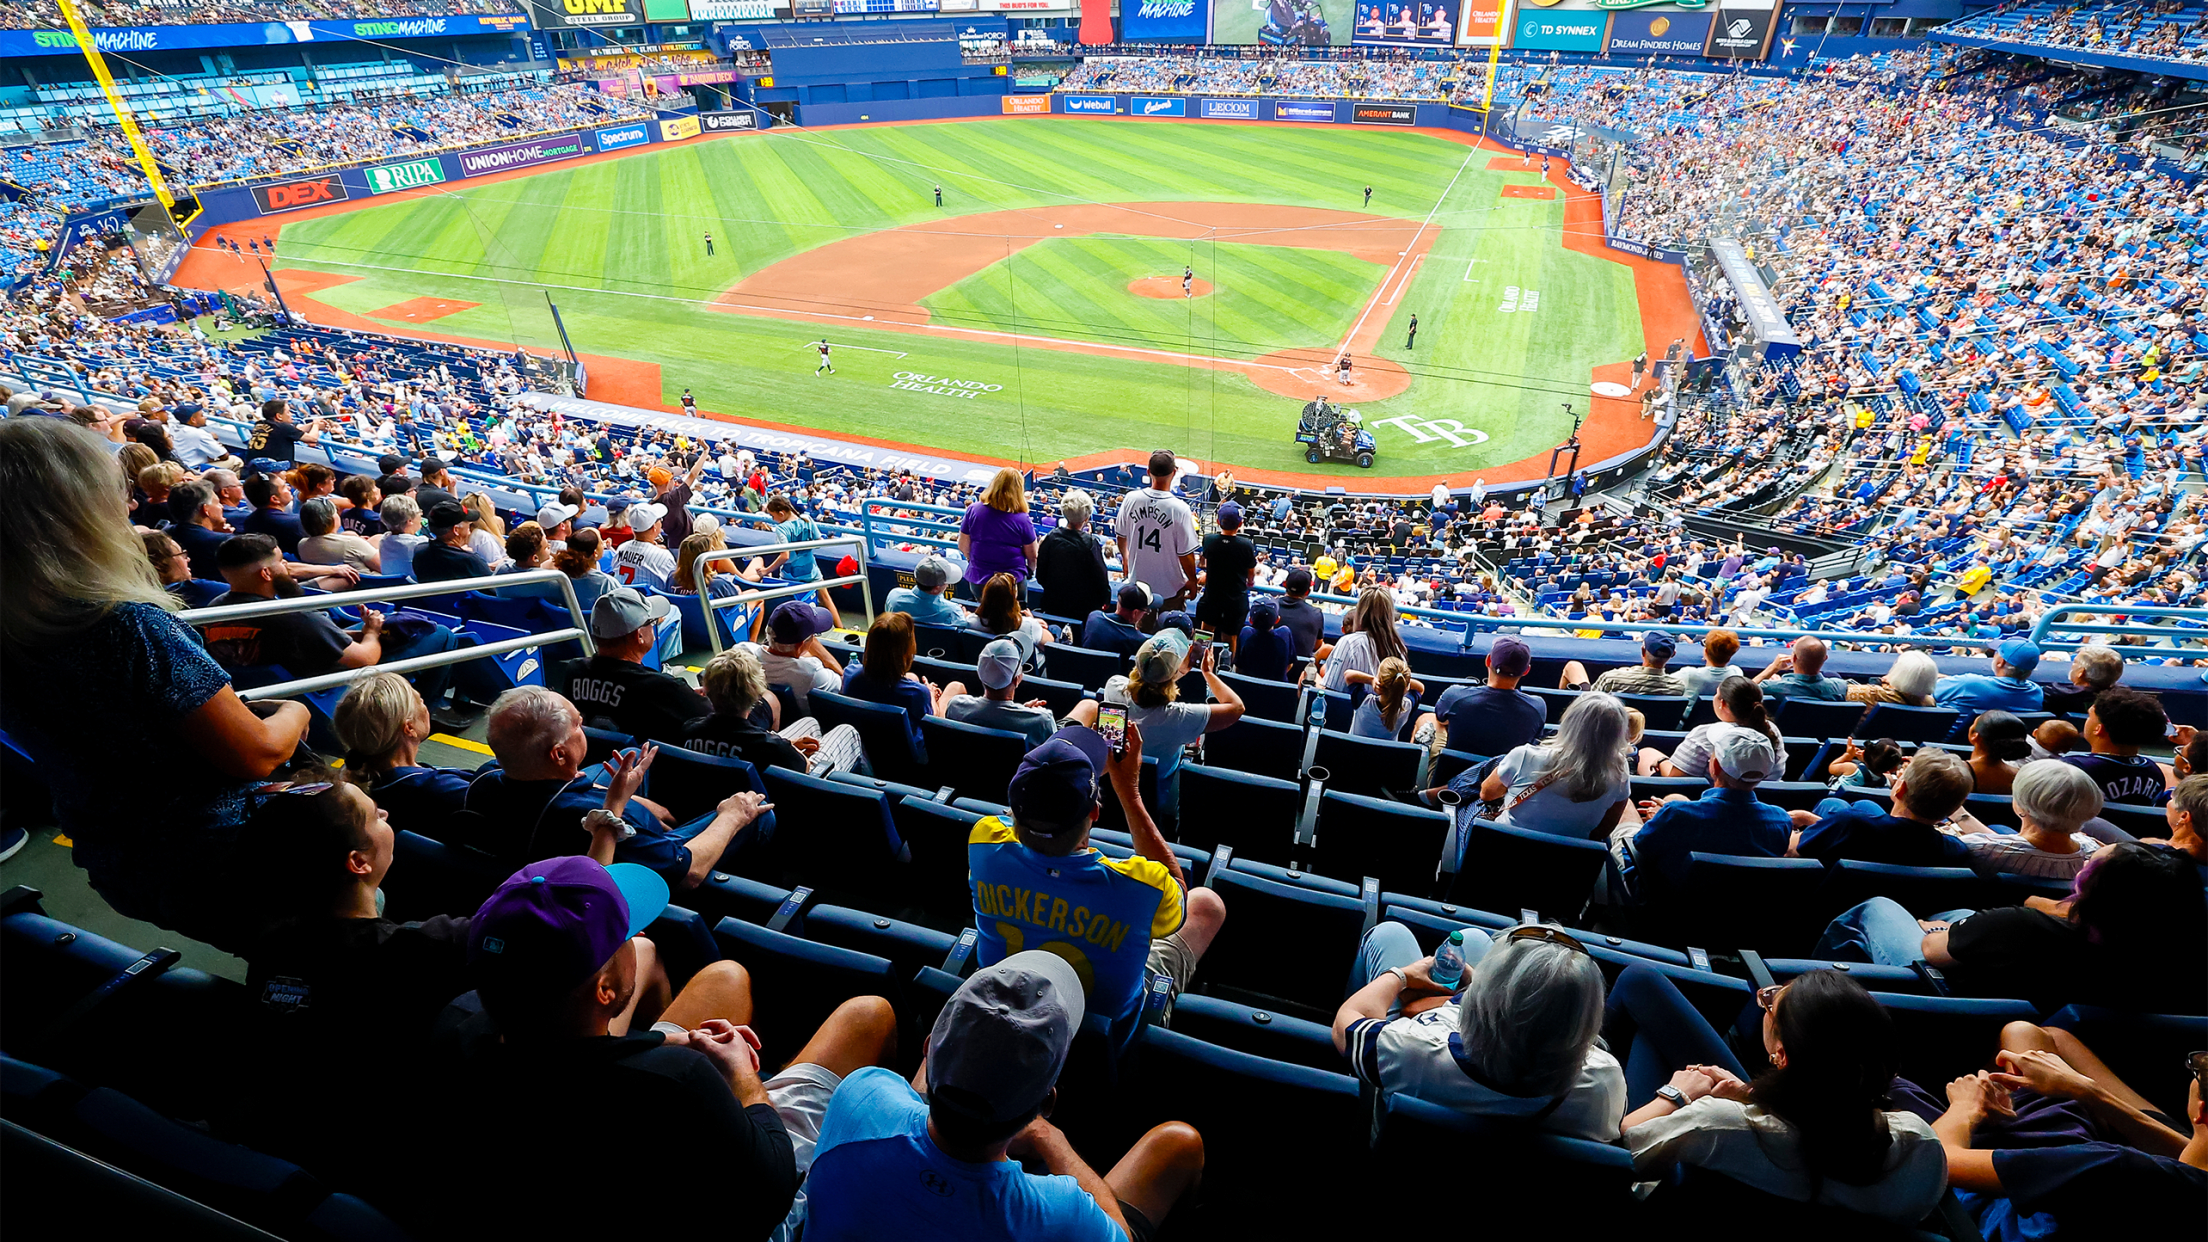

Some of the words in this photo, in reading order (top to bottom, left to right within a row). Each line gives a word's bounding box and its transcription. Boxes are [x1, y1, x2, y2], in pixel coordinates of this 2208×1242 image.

[569, 15, 599, 23] STEEL
[1137, 2, 1195, 19] MACHINE
[354, 22, 400, 36] STING
[399, 19, 447, 36] MACHINE
[1541, 24, 1554, 34] TD
[1555, 25, 1598, 36] SYNNEX
[95, 30, 158, 50] MACHINE
[1611, 38, 1639, 48] DREAM
[1639, 39, 1671, 50] FINDERS
[1672, 41, 1702, 51] HOMES
[717, 71, 734, 82] DECK
[1008, 97, 1044, 105] ORLANDO
[1013, 104, 1042, 112] HEALTH
[1083, 99, 1111, 110] Webull
[1208, 102, 1250, 113] LECOM
[1357, 110, 1392, 118] AMERANT
[1391, 111, 1410, 119] BANK
[600, 129, 641, 146] Spectrum
[466, 145, 544, 171] UNIONHOME
[542, 144, 579, 157] MORTGAGE
[392, 160, 440, 188] RIPA
[266, 178, 334, 209] DEX
[1610, 238, 1643, 255] RAYMOND
[1497, 285, 1521, 313] ORLANDO
[1518, 289, 1540, 312] HEALTH
[888, 380, 987, 400] HEALTH
[892, 371, 1004, 393] ORLANDO
[549, 400, 651, 424] WELCOME
[649, 415, 706, 437] BACK
[708, 425, 742, 439] TO
[746, 431, 876, 463] TROPICANA
[878, 454, 954, 476] FIELD
[1369, 414, 1490, 449] TB
[341, 517, 367, 535] ONES
[1129, 506, 1174, 530] SIMPSON
[1138, 525, 1162, 553] 14
[617, 550, 645, 566] MAUER
[619, 564, 636, 585] 7
[572, 678, 626, 707] BOGGS
[2103, 775, 2164, 801] OZARE
[977, 880, 1131, 953] DICKERSON
[268, 983, 309, 996] OPENING
[270, 992, 304, 1004] NIGHT
